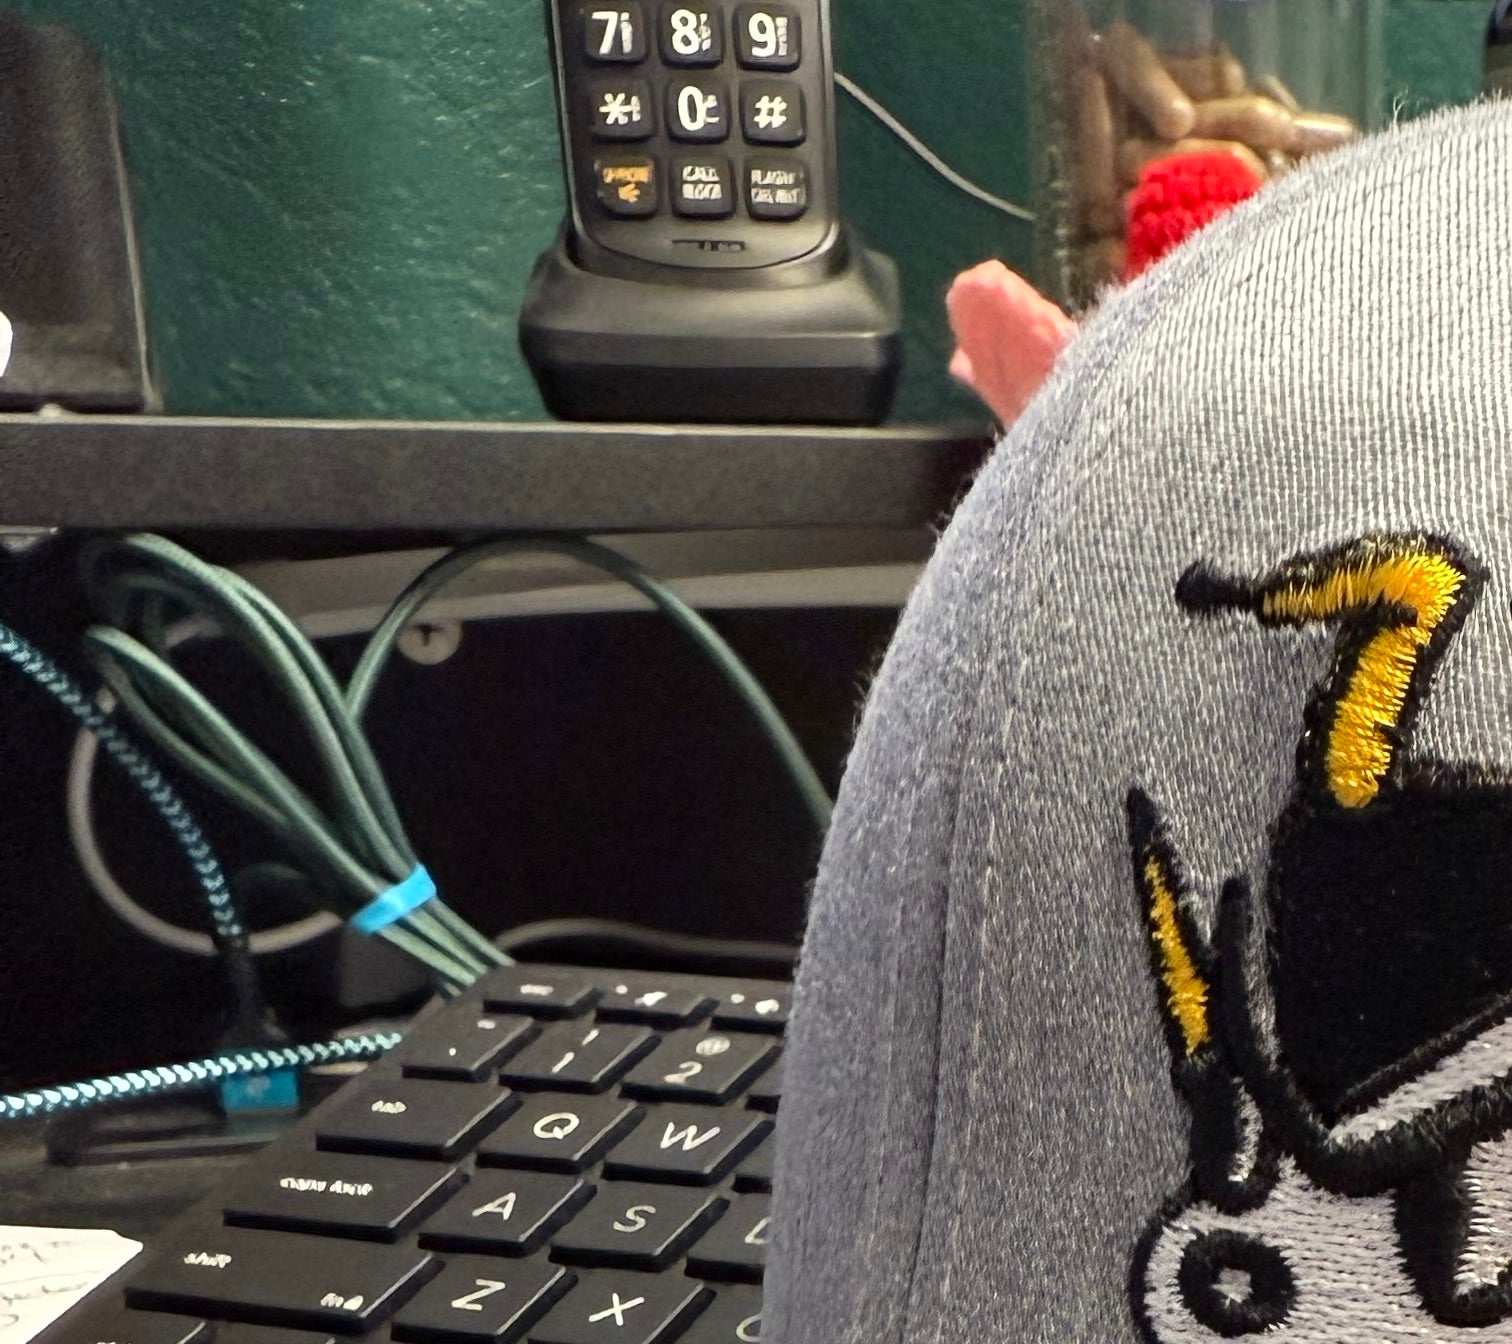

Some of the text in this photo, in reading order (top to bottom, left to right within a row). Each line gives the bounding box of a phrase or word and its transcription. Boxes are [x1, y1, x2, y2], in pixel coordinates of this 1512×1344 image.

[592, 11, 618, 54] 7
[671, 9, 699, 54] 8
[749, 13, 776, 57] 9
[664, 1060, 702, 1085] 2
[533, 1112, 580, 1140] Q
[660, 1122, 721, 1151] W
[472, 1192, 516, 1220] A
[613, 1205, 656, 1232] S
[451, 1278, 506, 1311] Z
[588, 1292, 645, 1326] X
